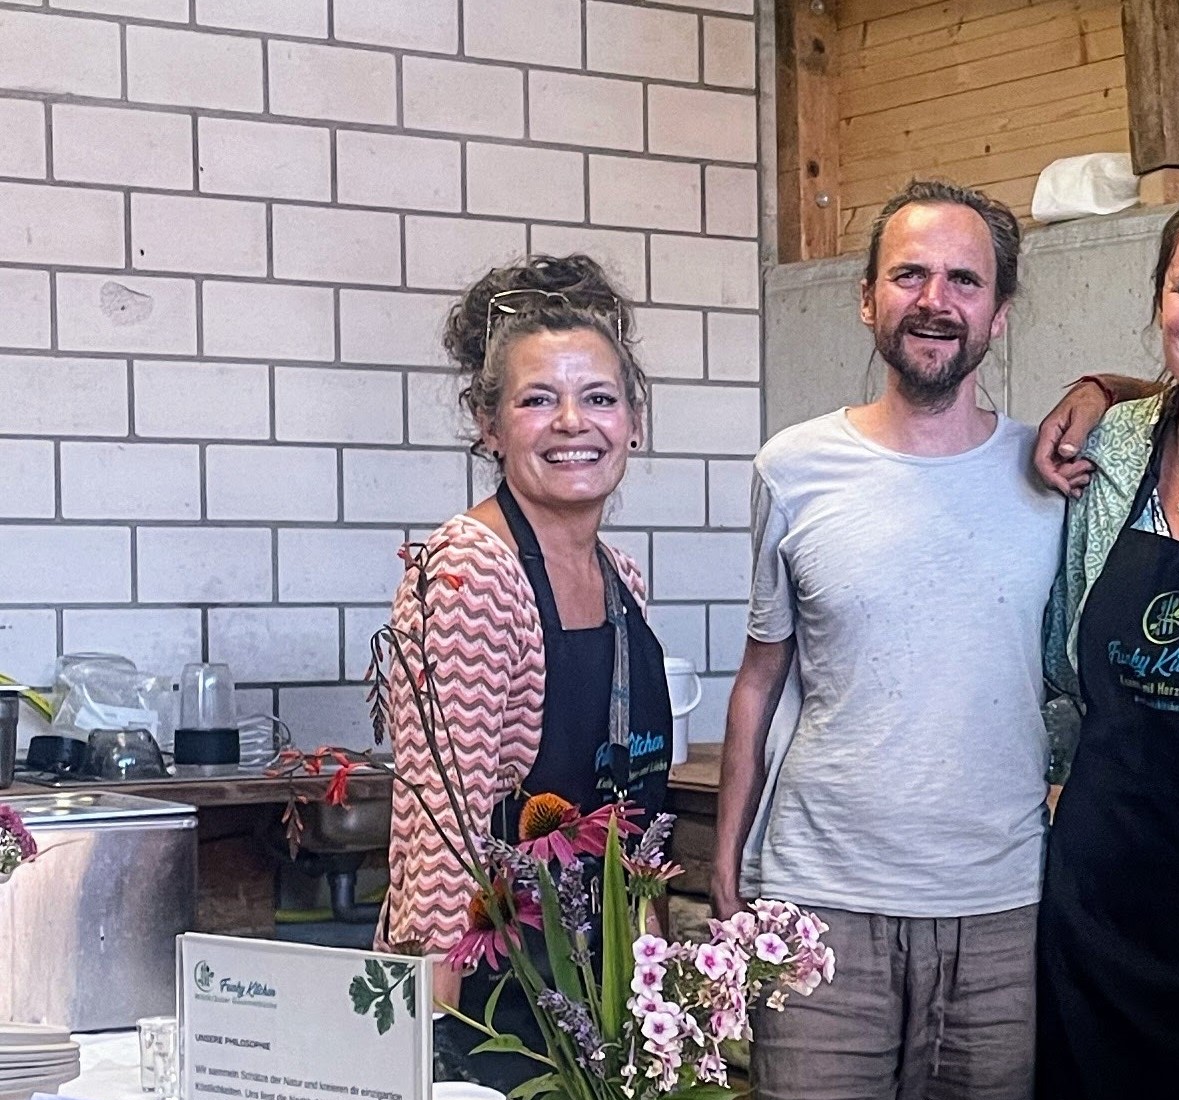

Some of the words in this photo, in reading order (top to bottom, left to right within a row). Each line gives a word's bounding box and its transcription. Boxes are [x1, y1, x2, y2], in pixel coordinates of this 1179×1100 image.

[1108, 641, 1150, 677] Funky
[1157, 681, 1179, 697] Herz
[629, 731, 664, 757] itchen
